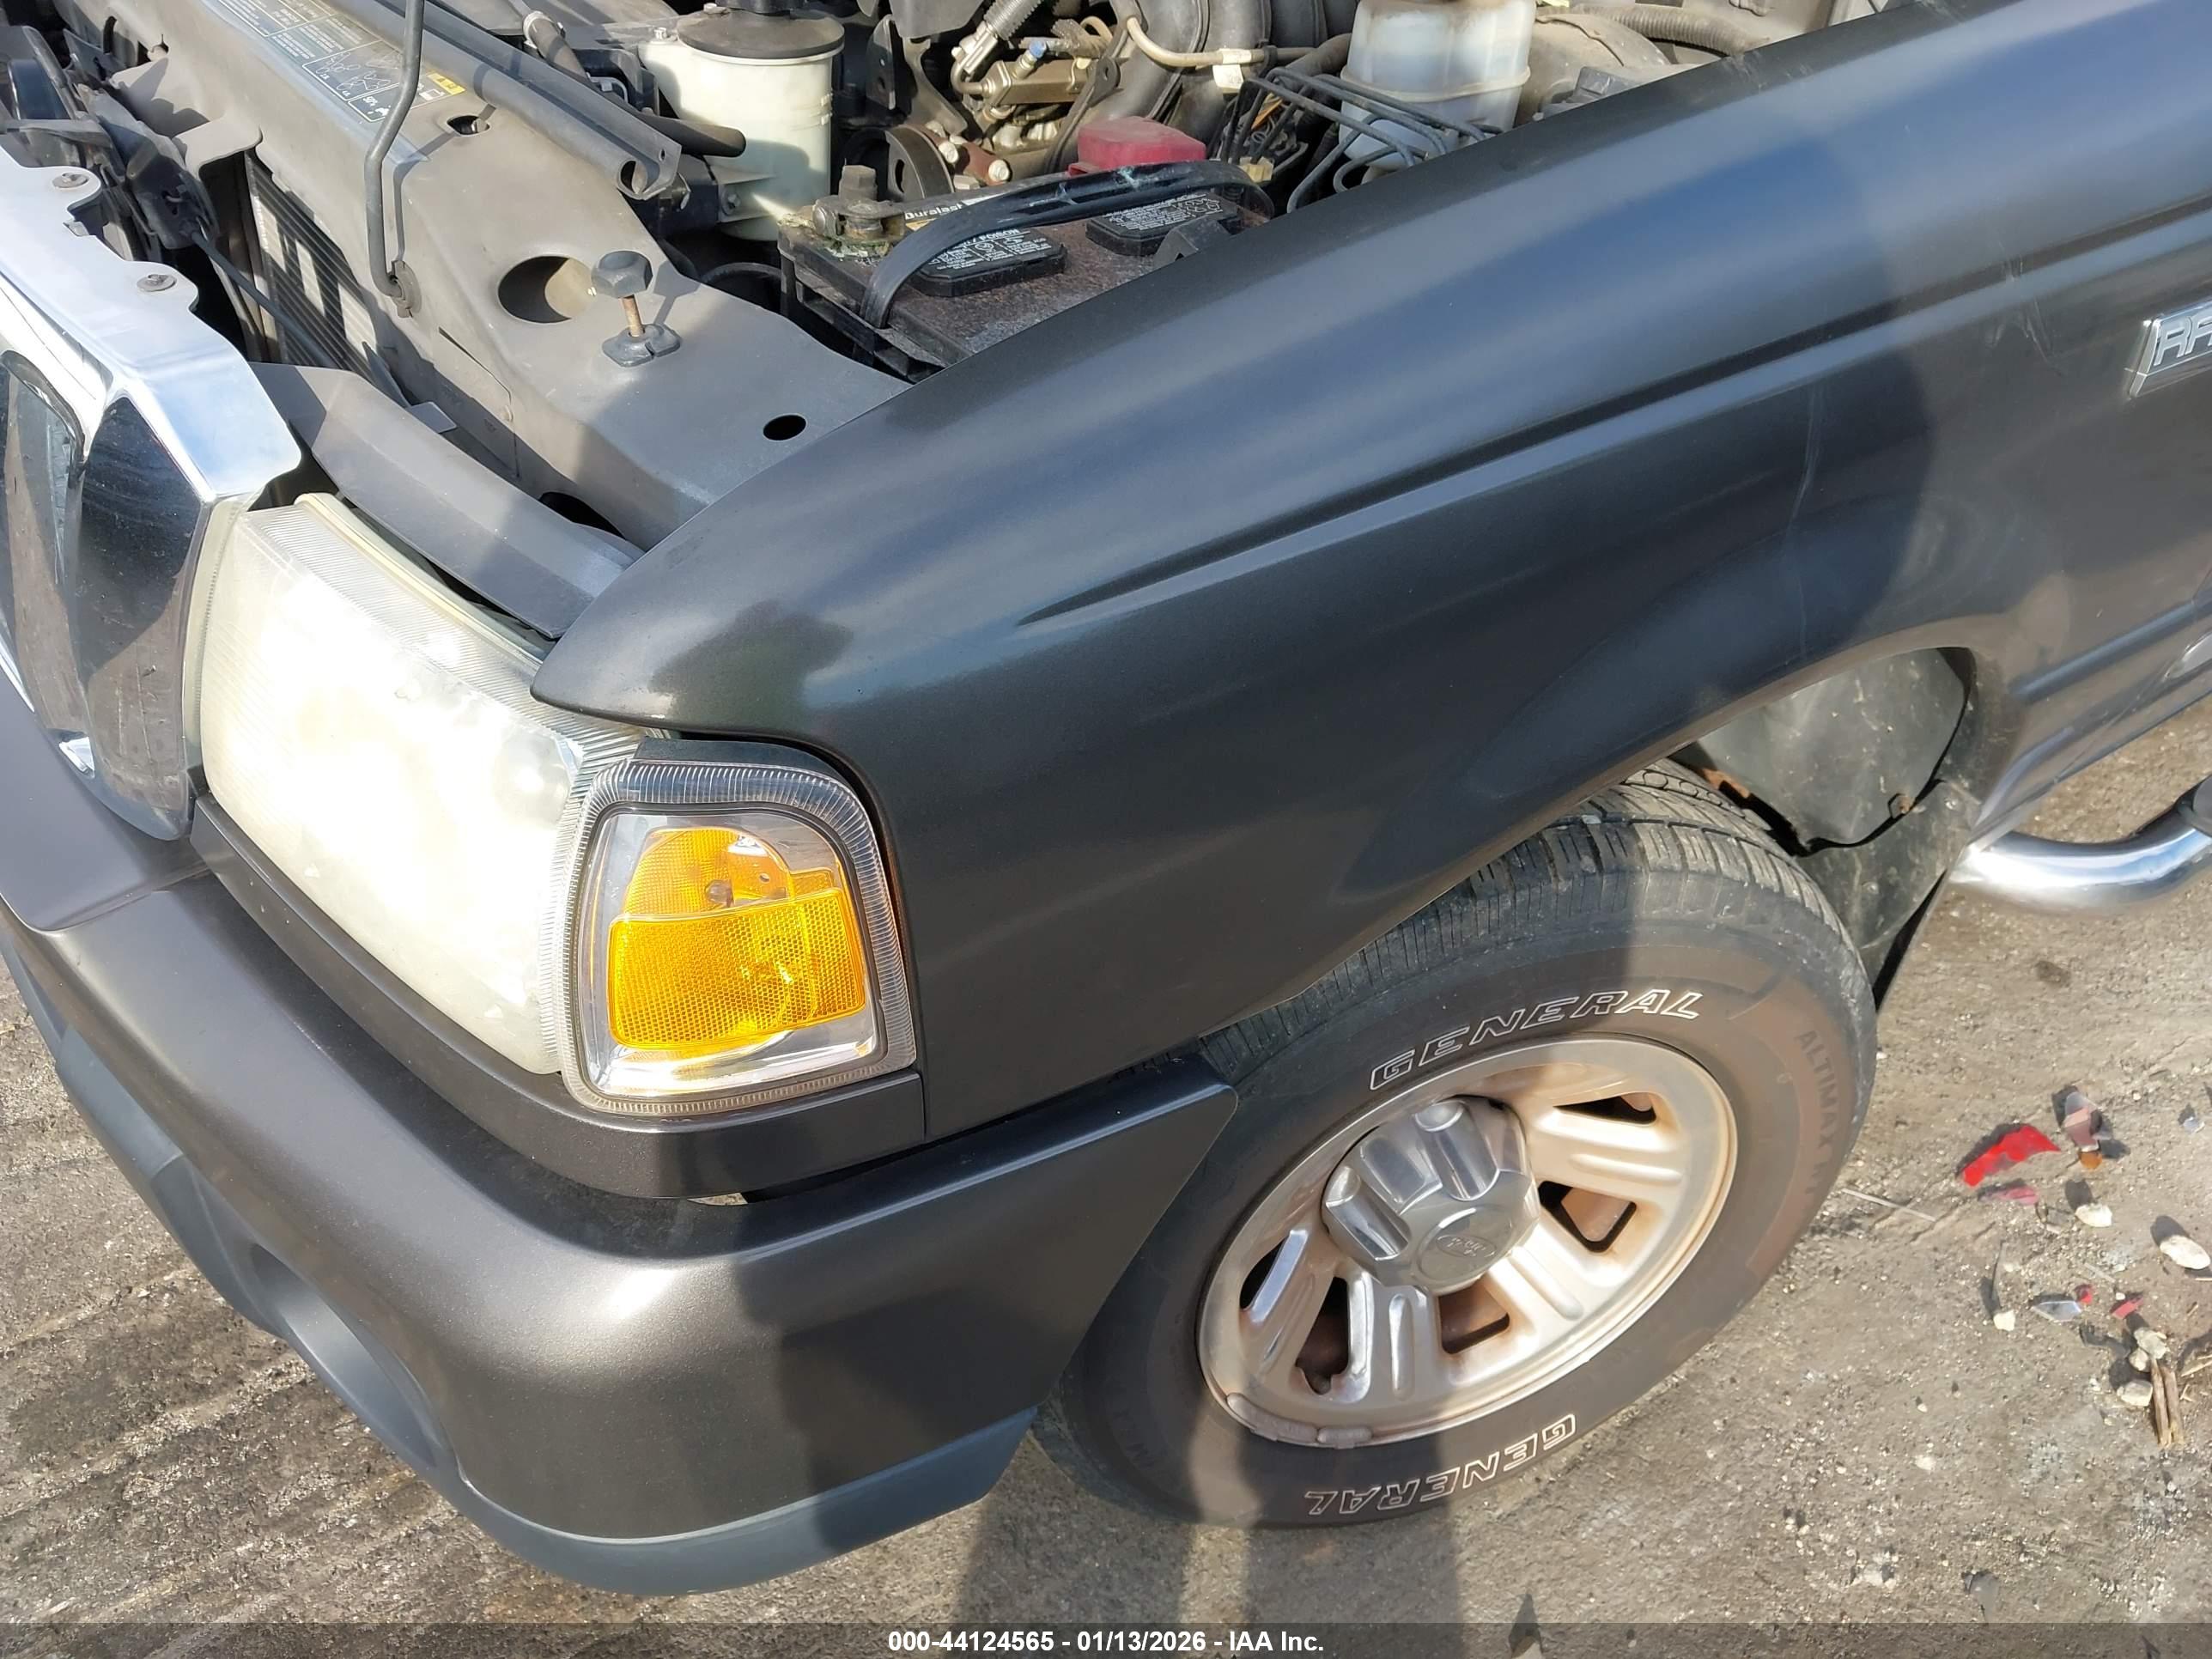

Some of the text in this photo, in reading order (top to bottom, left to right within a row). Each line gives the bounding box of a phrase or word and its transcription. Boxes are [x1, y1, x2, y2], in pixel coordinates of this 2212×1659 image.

[904, 203, 963, 220] Duralast
[1369, 989, 1704, 1091] GENERAL
[1794, 1030, 1838, 1150] ALTIMAX
[1304, 1413, 1577, 1516] GENERAL
